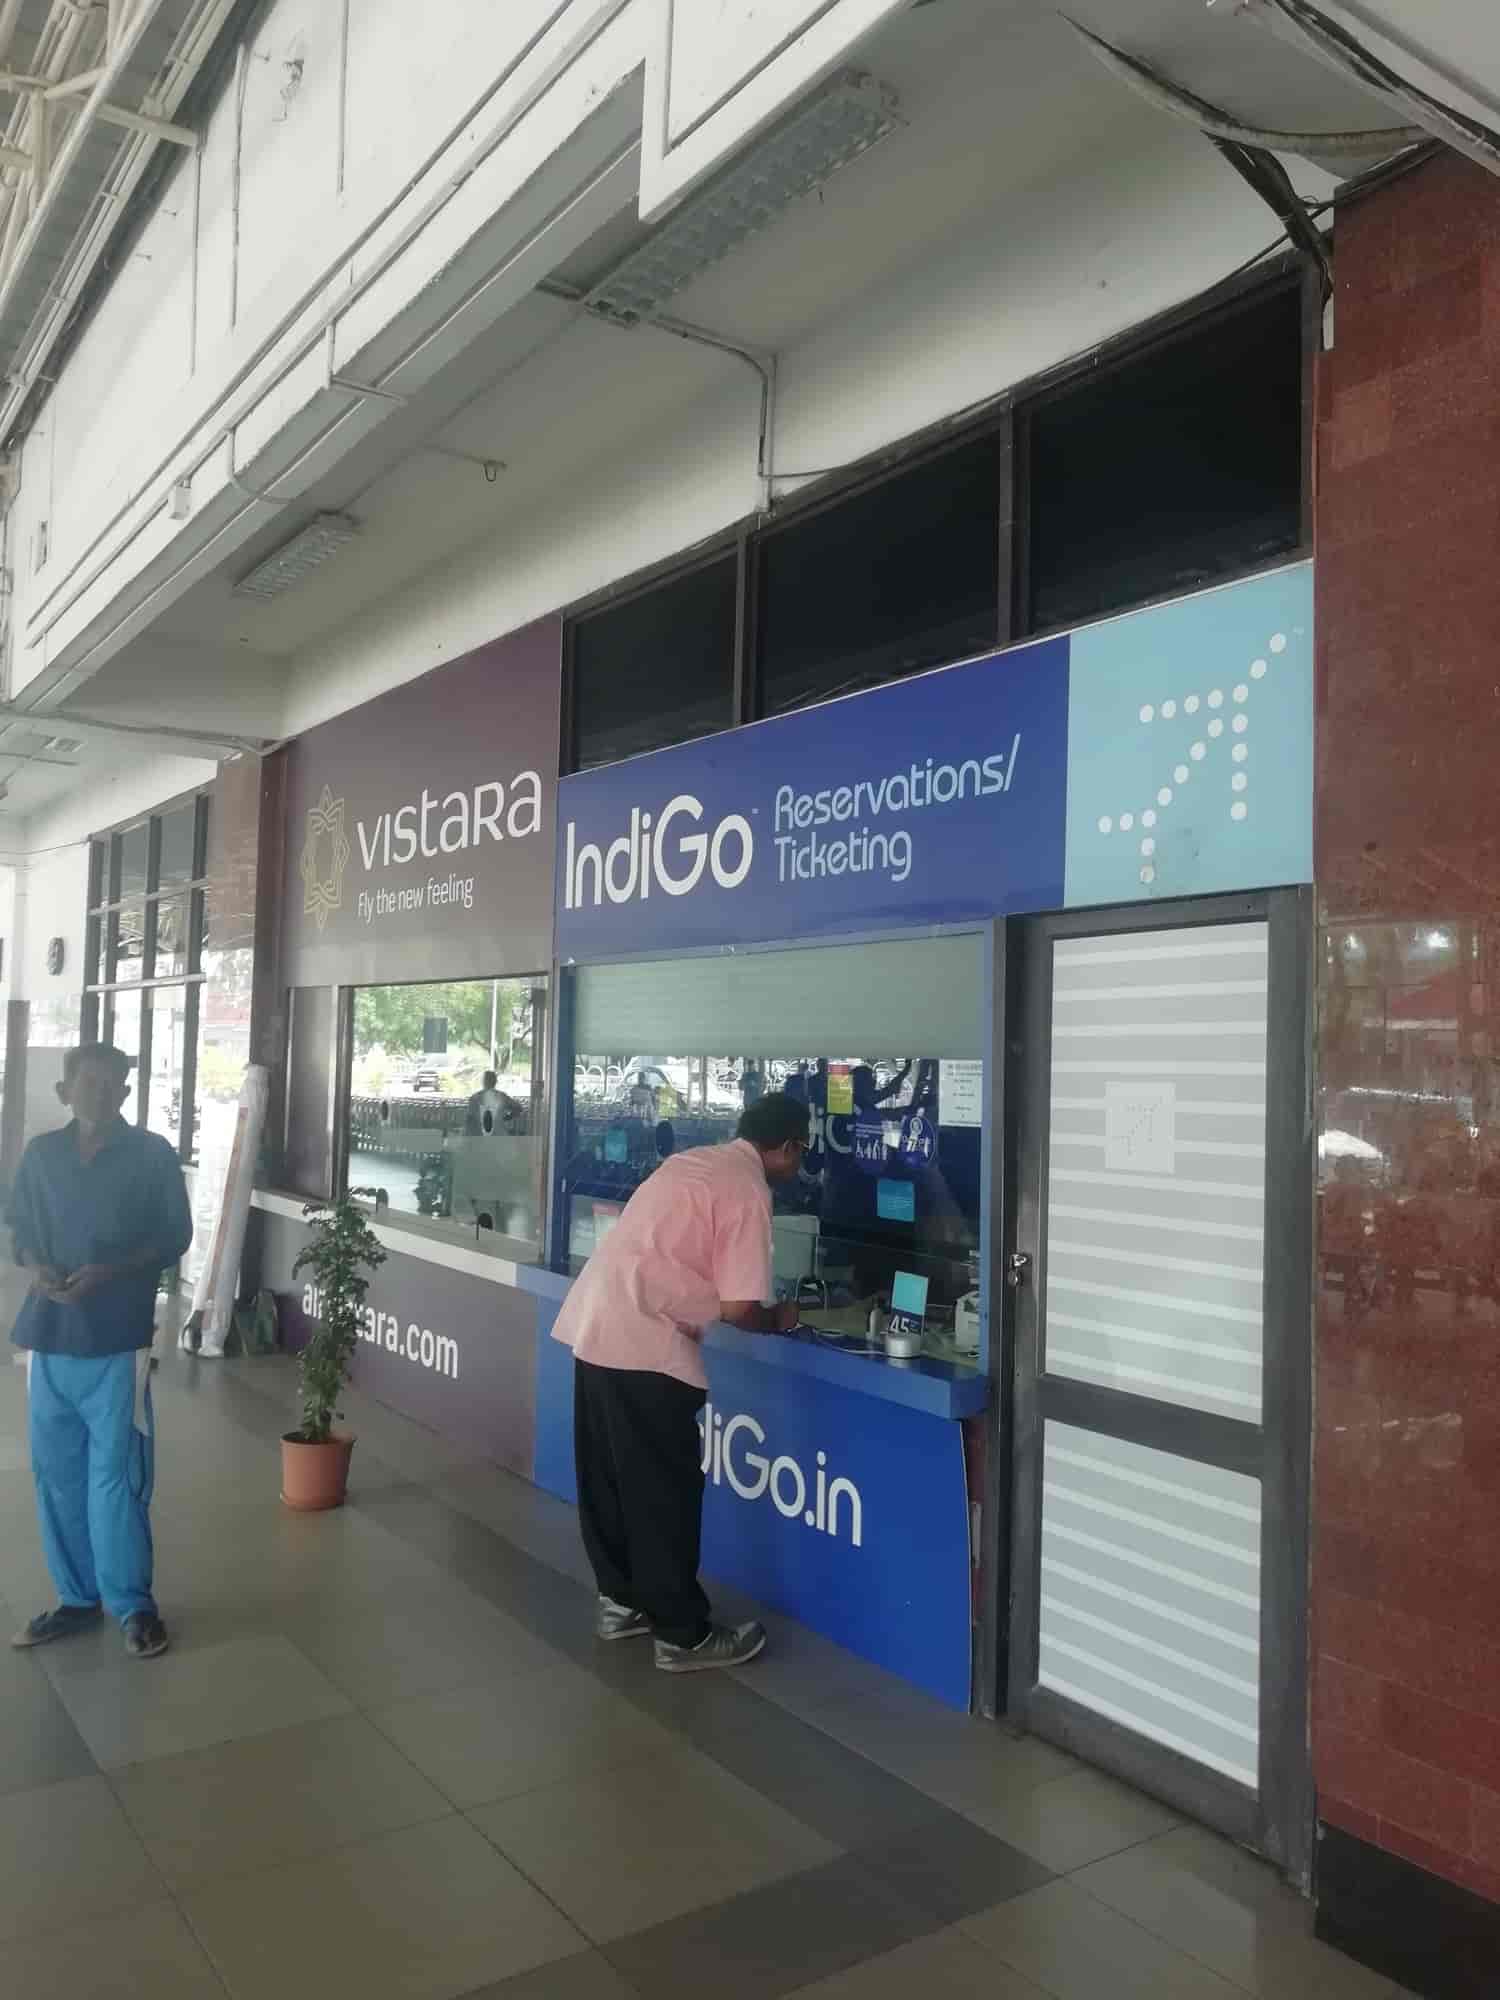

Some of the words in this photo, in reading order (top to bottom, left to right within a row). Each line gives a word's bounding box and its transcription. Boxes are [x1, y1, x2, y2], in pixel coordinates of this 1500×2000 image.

[774, 733, 1021, 832] Reservations/
[564, 794, 754, 910] IndiGo
[774, 826, 913, 882] Ticketing
[376, 887, 396, 915] the
[398, 886, 424, 912] new
[427, 872, 474, 909] feeling
